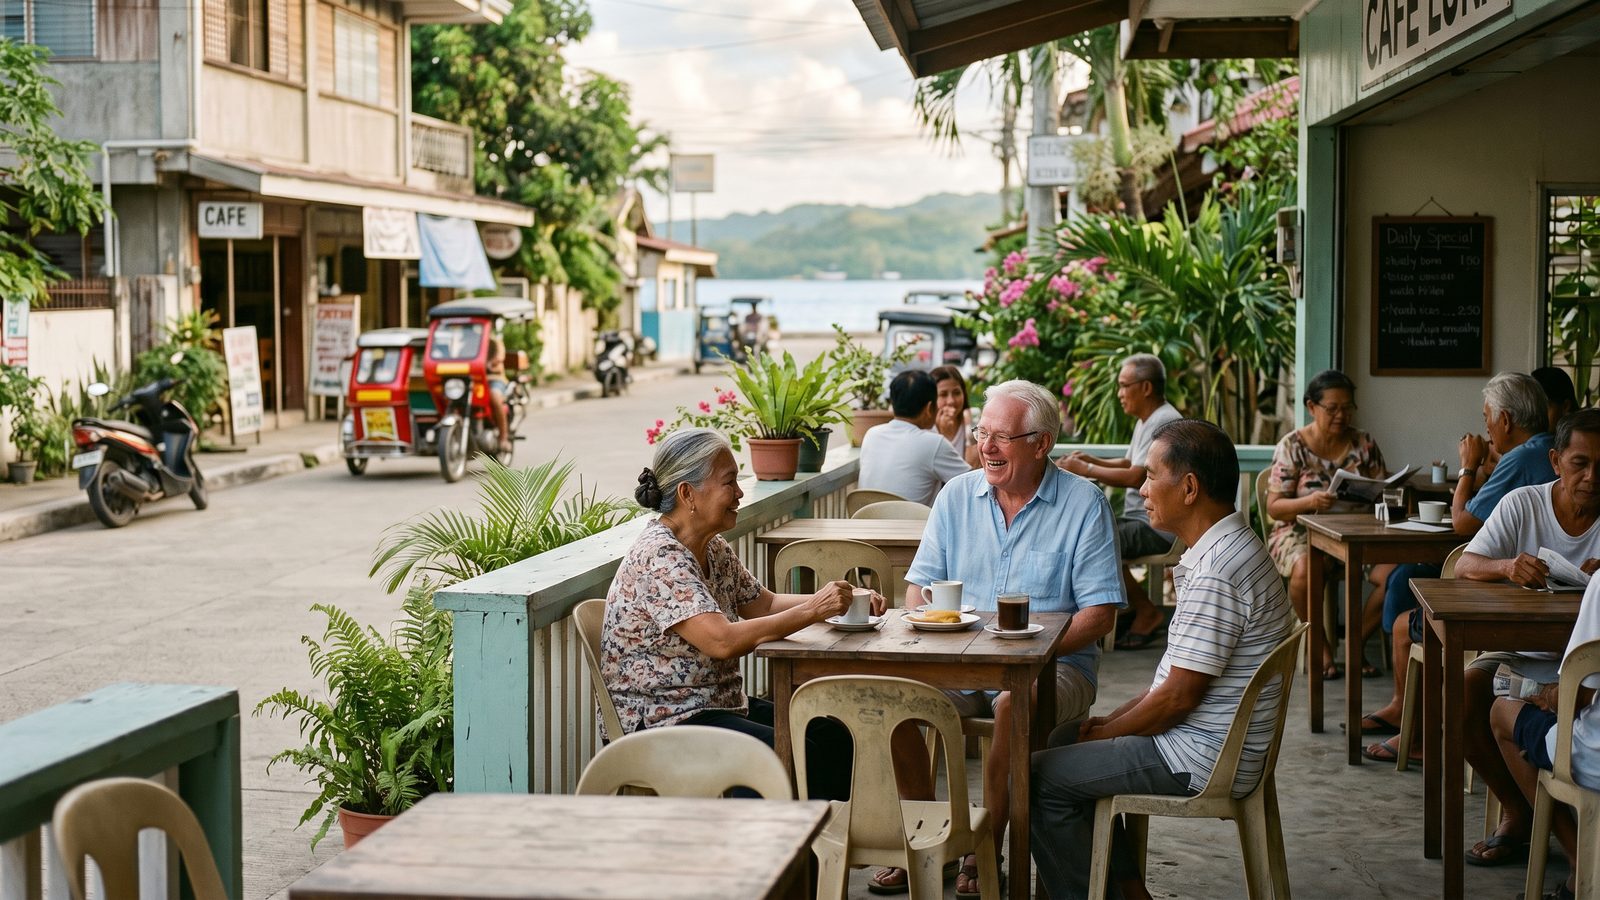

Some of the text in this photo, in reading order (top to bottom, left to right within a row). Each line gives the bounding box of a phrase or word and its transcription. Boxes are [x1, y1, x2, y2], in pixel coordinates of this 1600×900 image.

[1366, 0, 1419, 70] CAFE
[205, 206, 246, 226] CAFE
[1387, 226, 1473, 251] Daily Special
